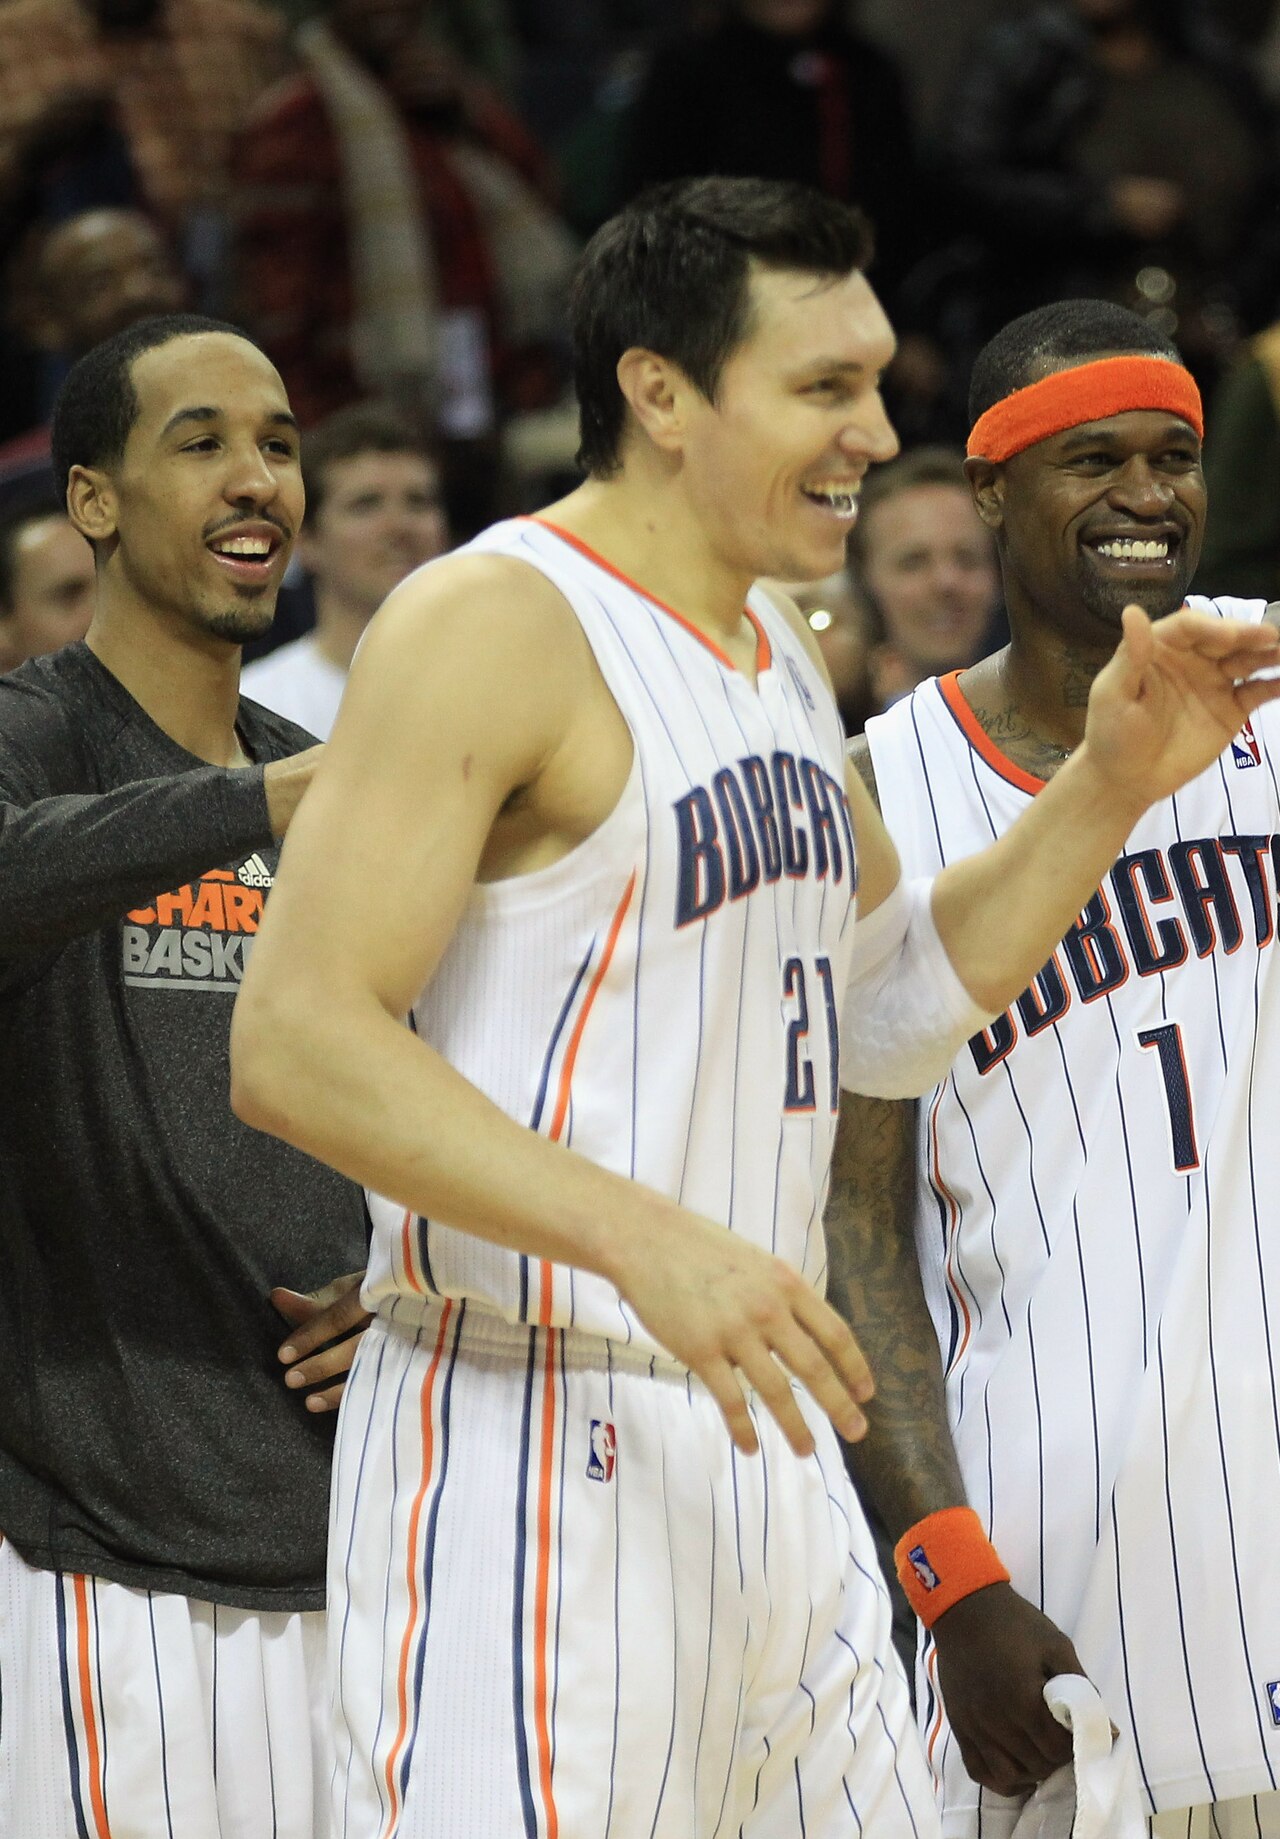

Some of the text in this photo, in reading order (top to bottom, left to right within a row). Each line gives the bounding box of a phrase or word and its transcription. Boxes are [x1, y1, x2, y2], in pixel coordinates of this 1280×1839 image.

[1235, 756, 1255, 768] NBA
[782, 957, 840, 1115] 21
[1137, 1022, 1201, 1172] 1
